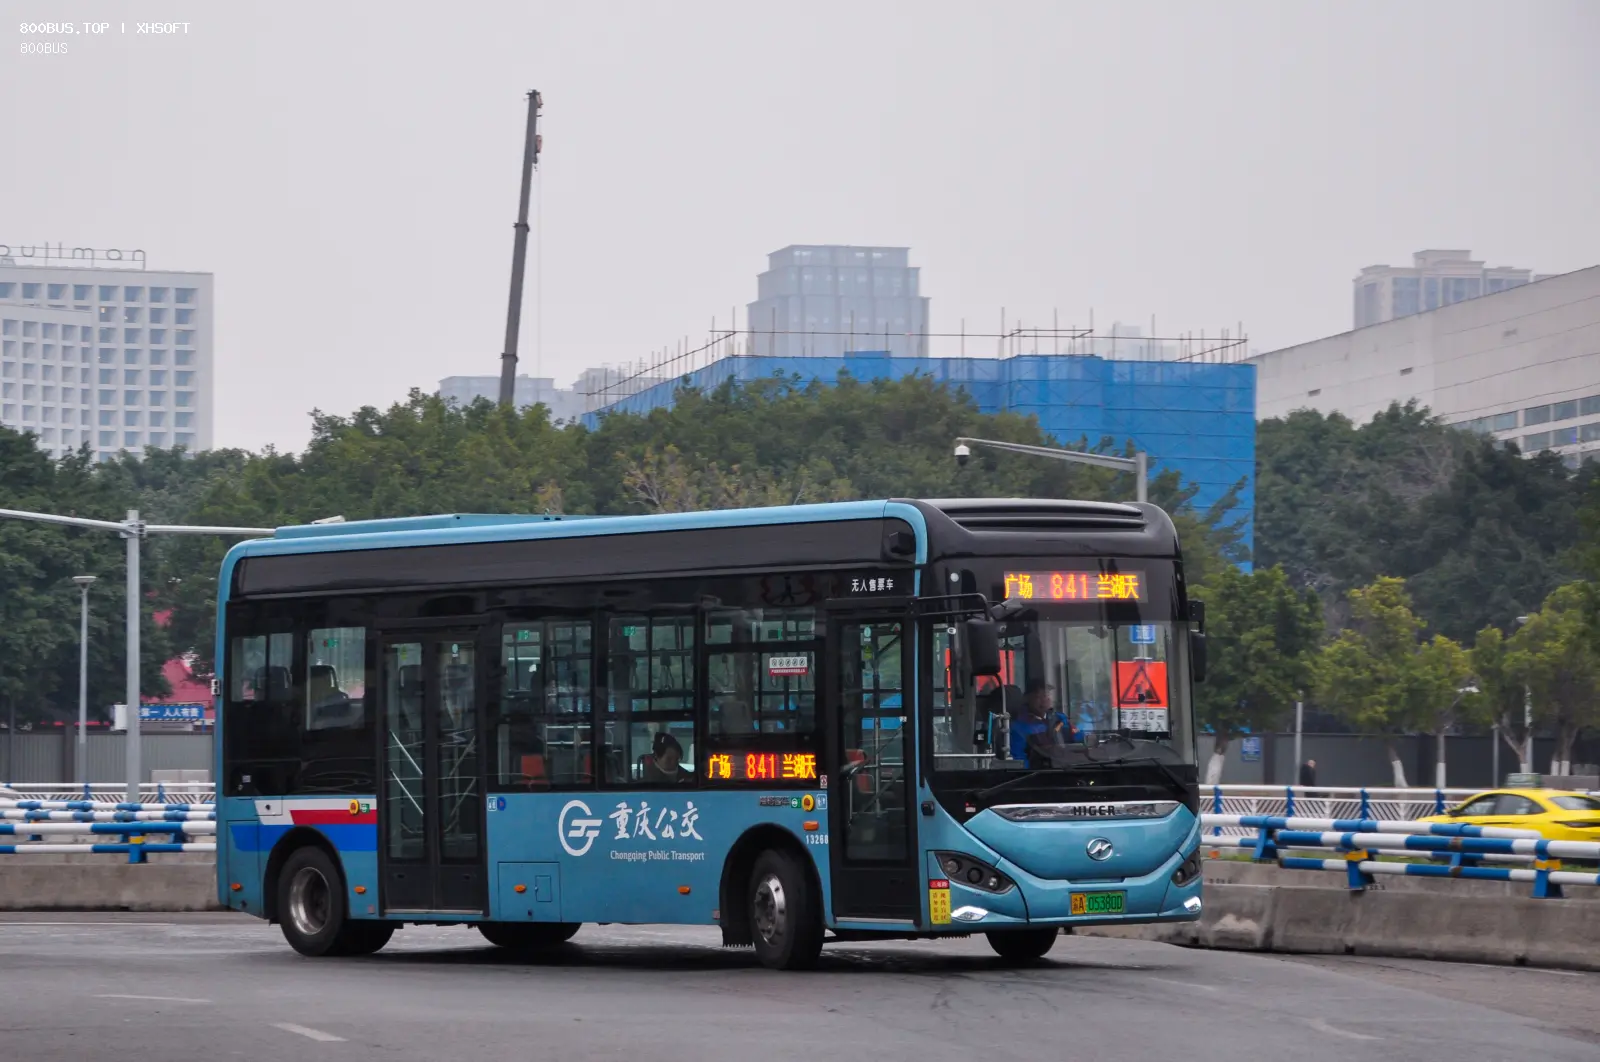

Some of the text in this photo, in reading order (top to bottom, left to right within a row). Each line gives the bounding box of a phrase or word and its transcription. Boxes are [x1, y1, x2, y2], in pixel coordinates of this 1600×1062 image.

[851, 577, 894, 592] 无人售票车
[1004, 573, 1139, 599] 广场 841 兰湖天
[708, 753, 816, 779] 广场 841 兰湖天
[1073, 805, 1116, 816] HIGER
[608, 801, 704, 841] 重庆公交
[610, 850, 705, 863] Chongqing Public Transport
